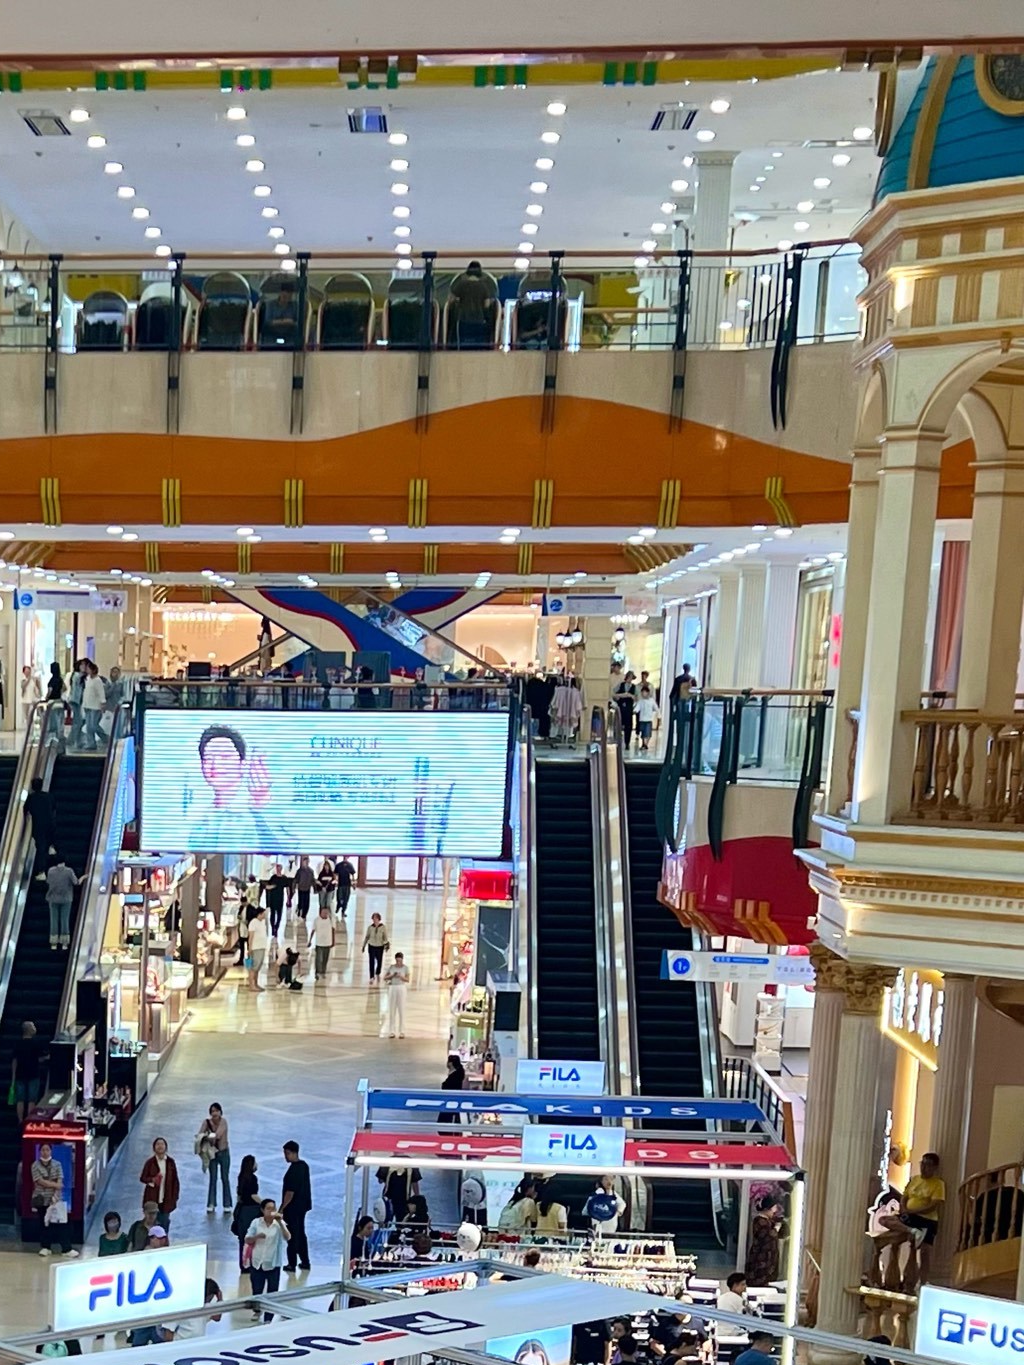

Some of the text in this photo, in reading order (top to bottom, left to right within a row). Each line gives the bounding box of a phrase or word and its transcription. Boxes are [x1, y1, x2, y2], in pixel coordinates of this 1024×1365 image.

[539, 1067, 581, 1081] FILA
[405, 1098, 698, 1116] FILA KIDS
[548, 1133, 598, 1150] FILA
[89, 1265, 173, 1311] FILA
